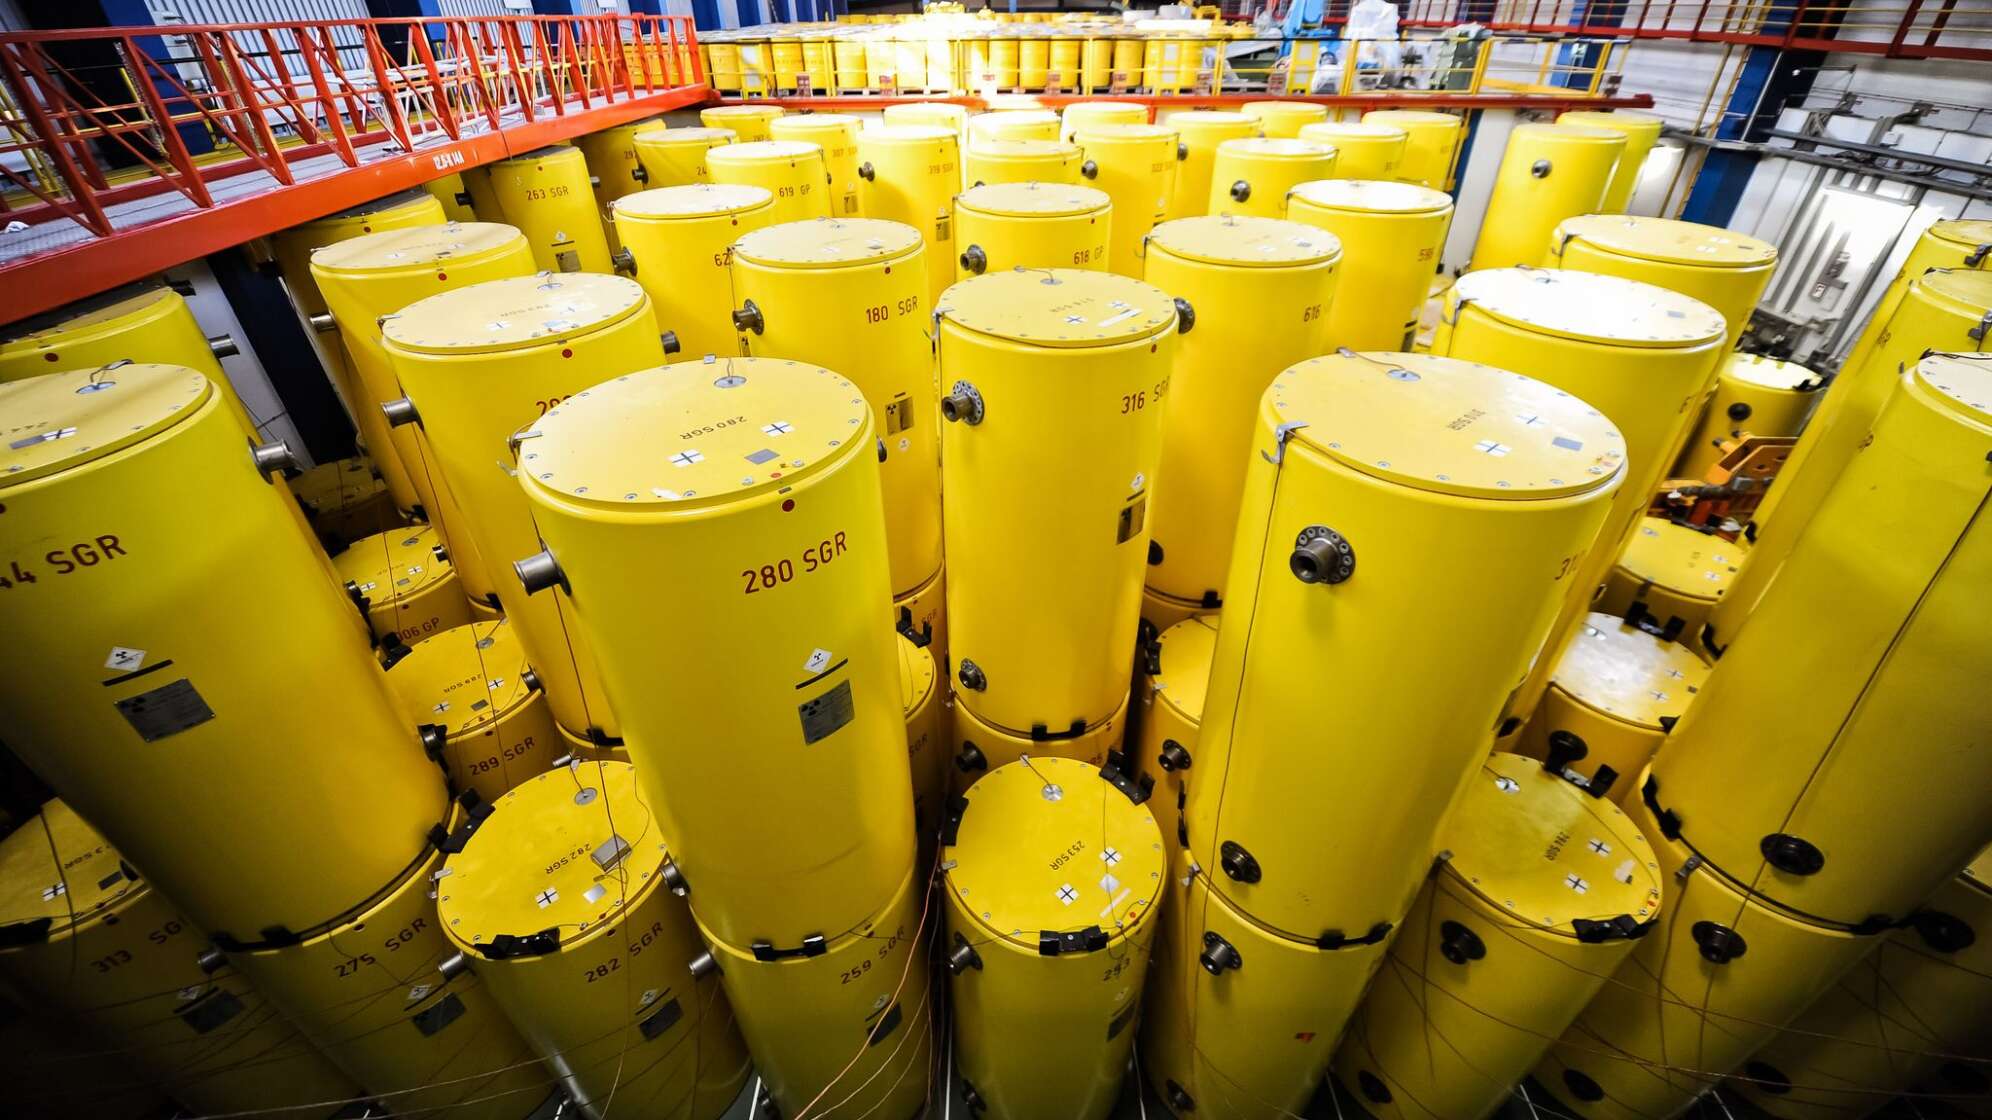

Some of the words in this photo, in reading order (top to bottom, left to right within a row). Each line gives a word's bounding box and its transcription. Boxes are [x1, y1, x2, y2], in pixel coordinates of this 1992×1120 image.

[526, 190, 546, 201] 263
[550, 186, 569, 198] SGR
[778, 187, 794, 198] 619
[1073, 250, 1090, 265] 618
[866, 305, 889, 324] 180
[898, 295, 918, 316] SGR
[1121, 391, 1145, 415] 316
[679, 426, 715, 440] SGR
[45, 534, 127, 575] SGR
[741, 559, 794, 595] 280
[802, 531, 847, 573] SGR
[422, 617, 440, 635] GP
[469, 756, 500, 777] 289
[503, 736, 536, 761] SGR
[570, 843, 592, 860] 282
[1067, 840, 1086, 857] 253
[545, 857, 569, 874] SGR
[1049, 853, 1070, 871] SGR
[334, 953, 377, 977] 275
[384, 918, 428, 952] SGR
[584, 957, 622, 983] 282
[629, 921, 664, 957] SGR
[840, 959, 873, 985] 259
[878, 925, 905, 960] SGR
[90, 950, 133, 974] 313
